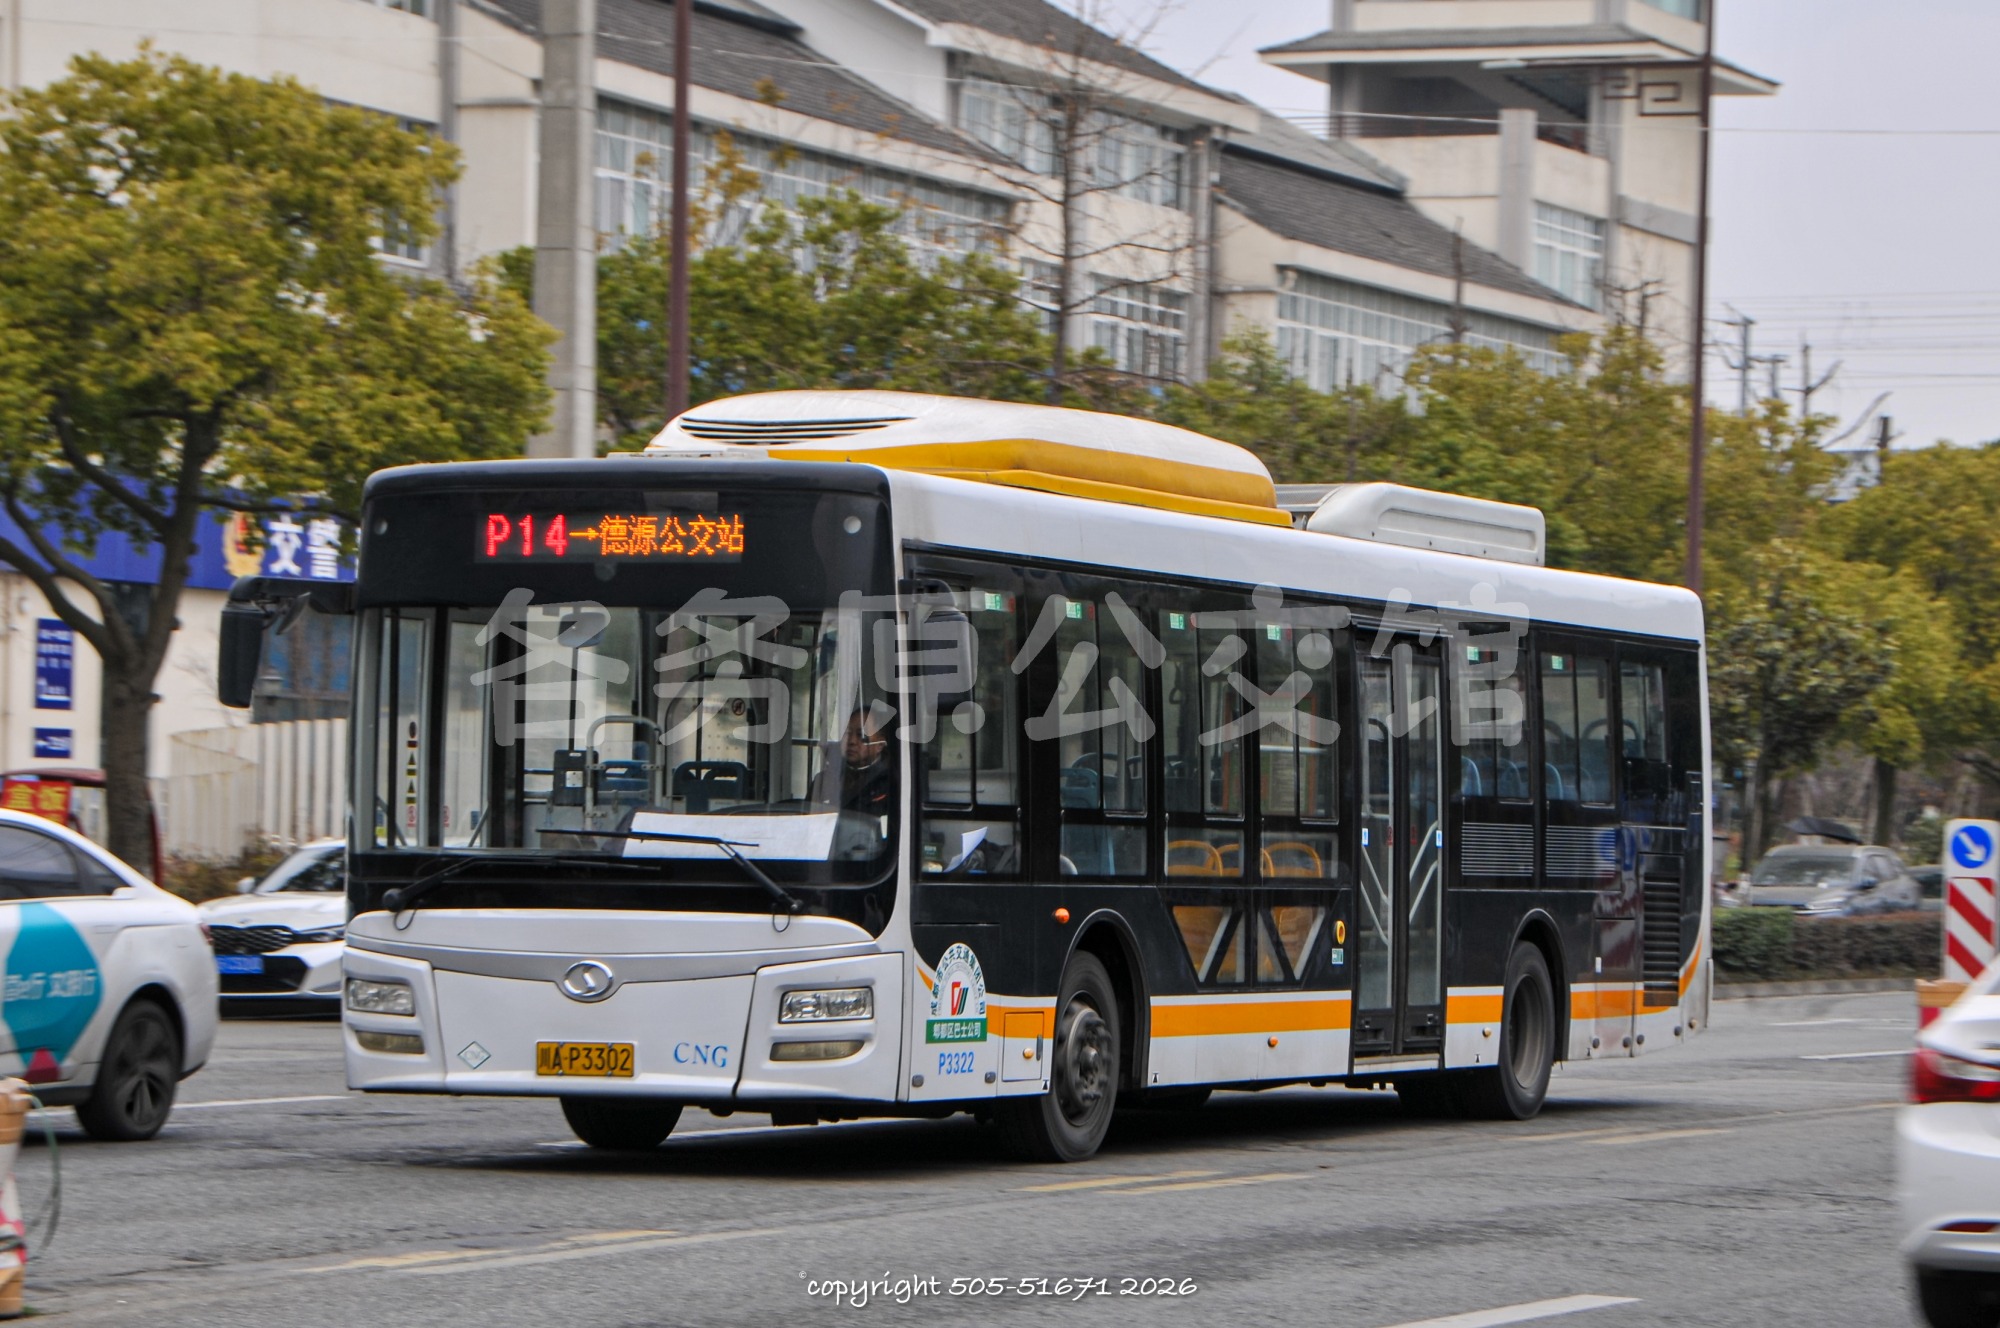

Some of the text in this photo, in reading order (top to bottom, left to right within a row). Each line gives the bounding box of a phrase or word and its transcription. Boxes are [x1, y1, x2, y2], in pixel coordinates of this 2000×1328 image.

[268, 513, 361, 579] 交警
[487, 514, 744, 556] P14 德源公交站
[673, 1042, 729, 1068] CNG
[938, 1051, 975, 1075] P3322
